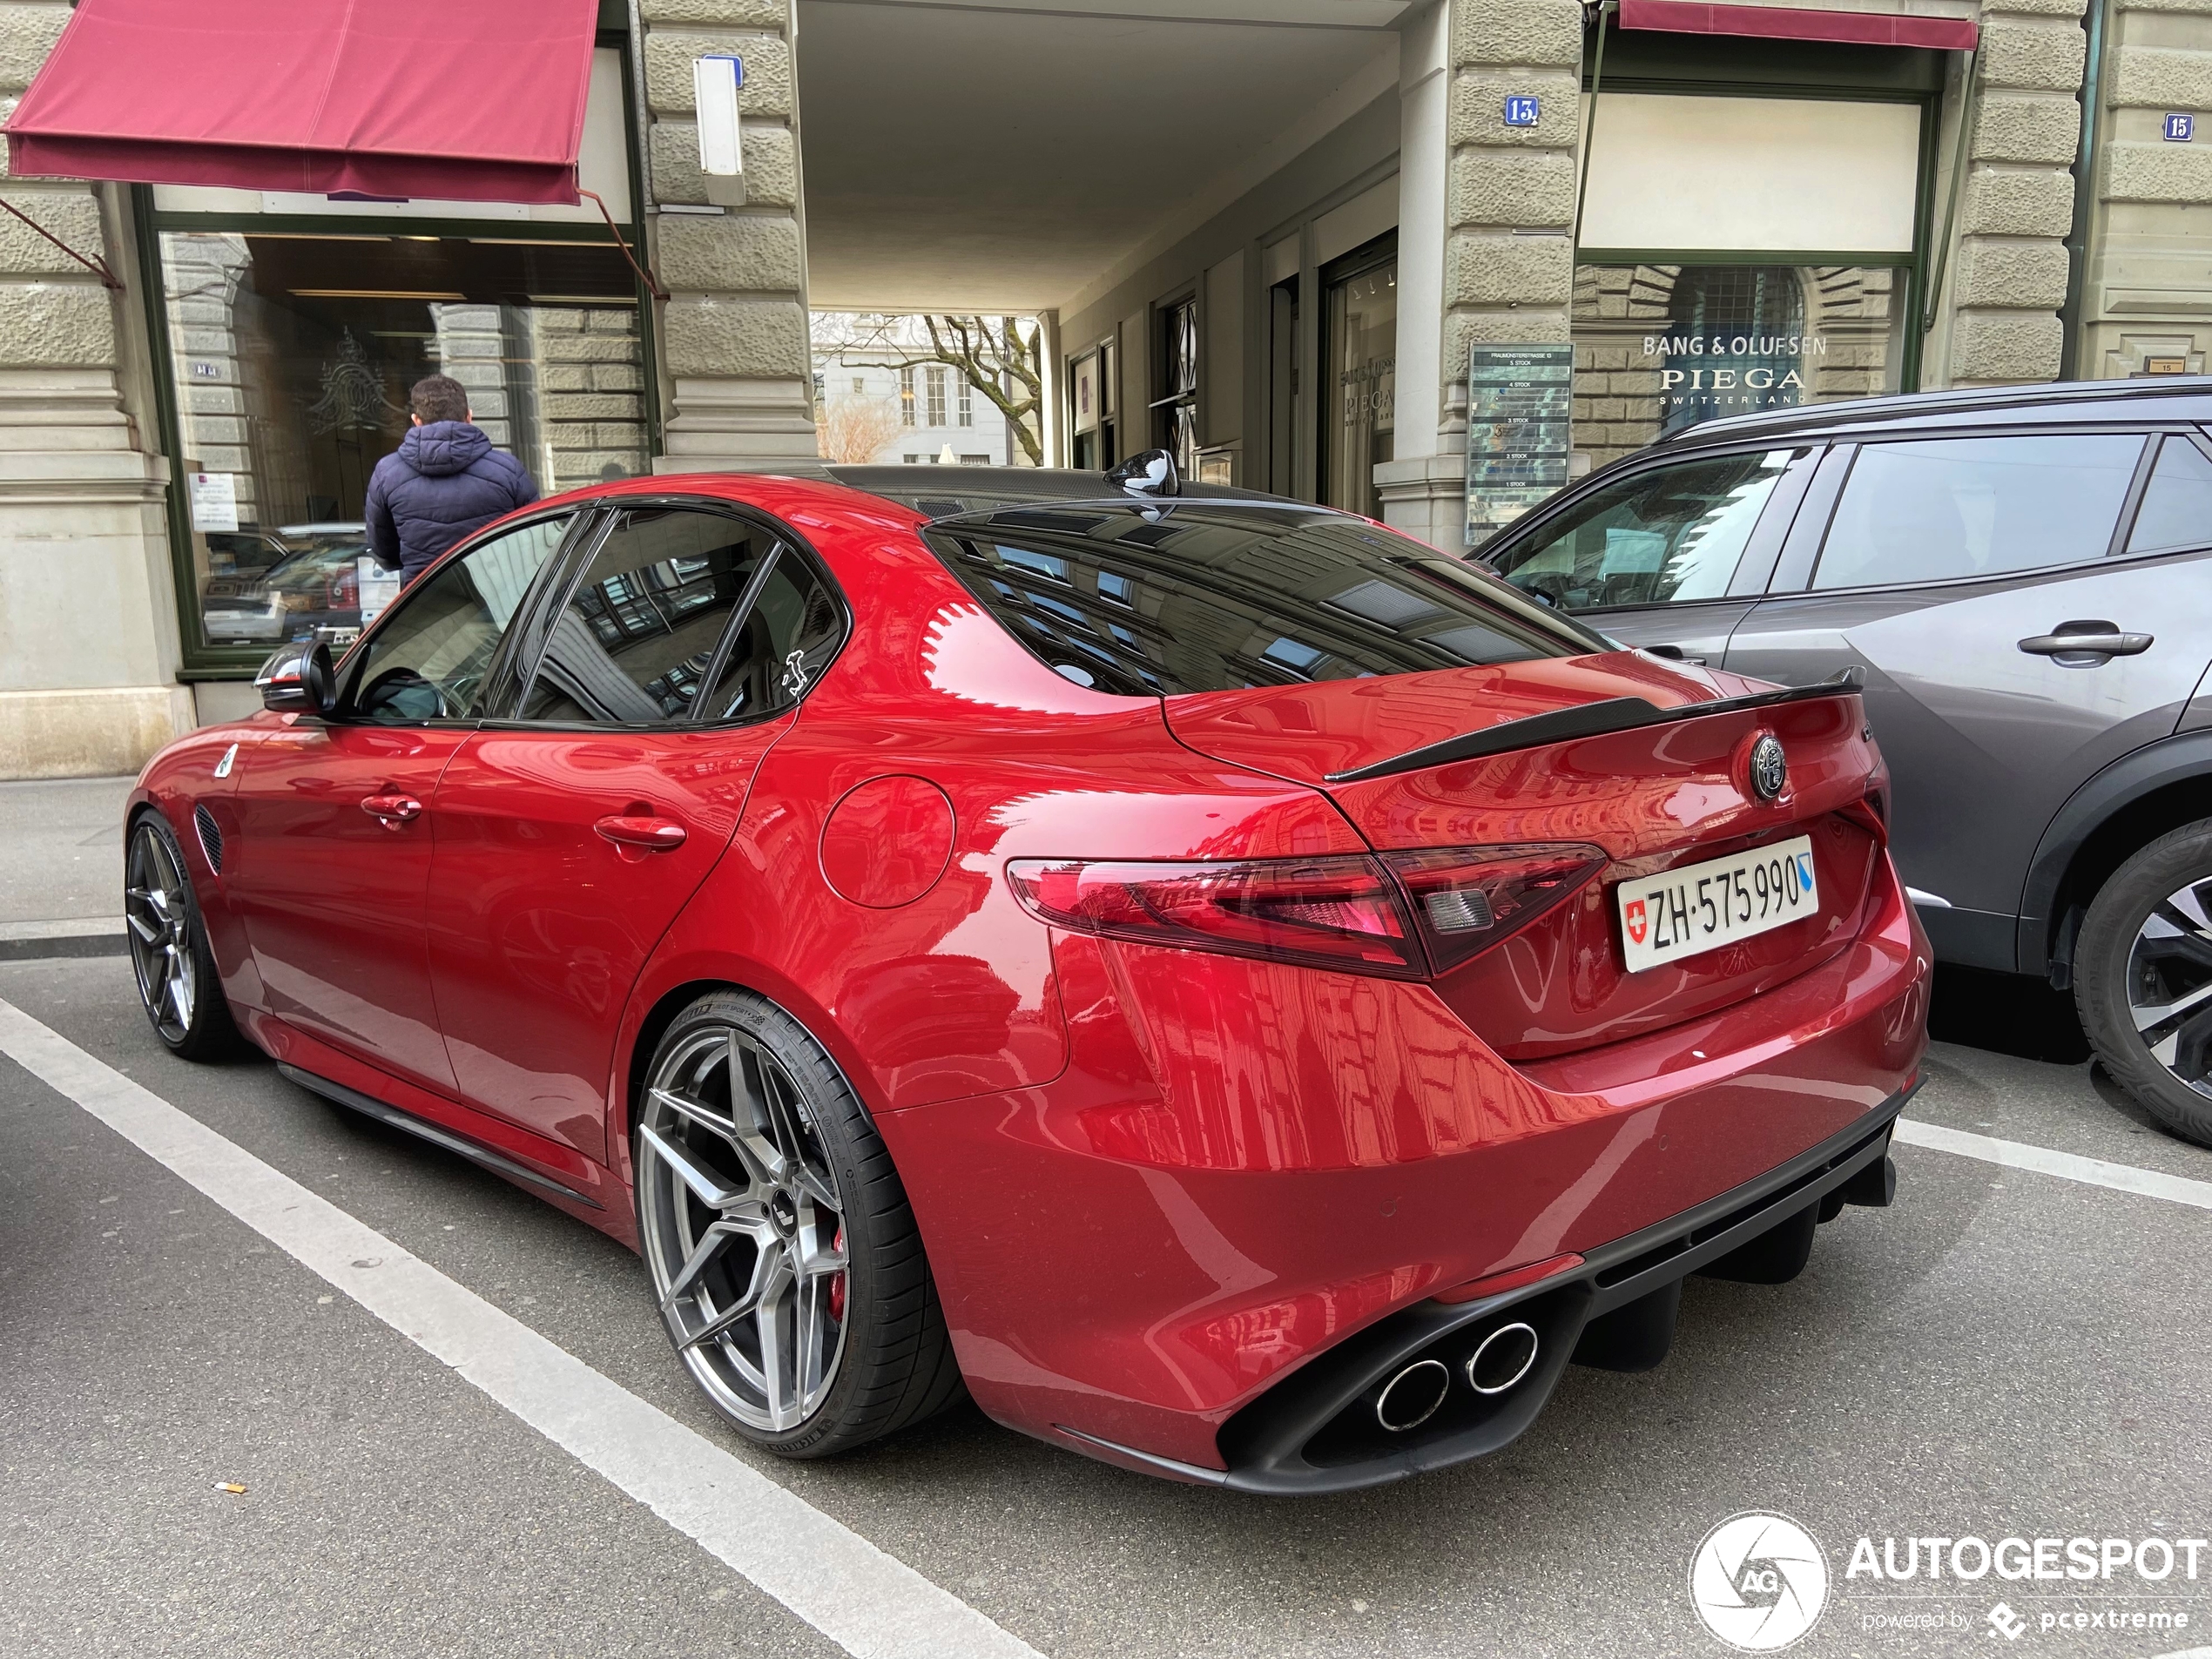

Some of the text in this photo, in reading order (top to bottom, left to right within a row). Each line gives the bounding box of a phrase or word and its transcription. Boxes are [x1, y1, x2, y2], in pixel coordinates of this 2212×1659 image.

[1510, 100, 1533, 121] 13
[2171, 118, 2188, 137] 15
[1643, 336, 1827, 356] BANG & OLUFSEN
[1660, 368, 1806, 390] PIEGA
[1660, 395, 1806, 405] SWITZERLAND
